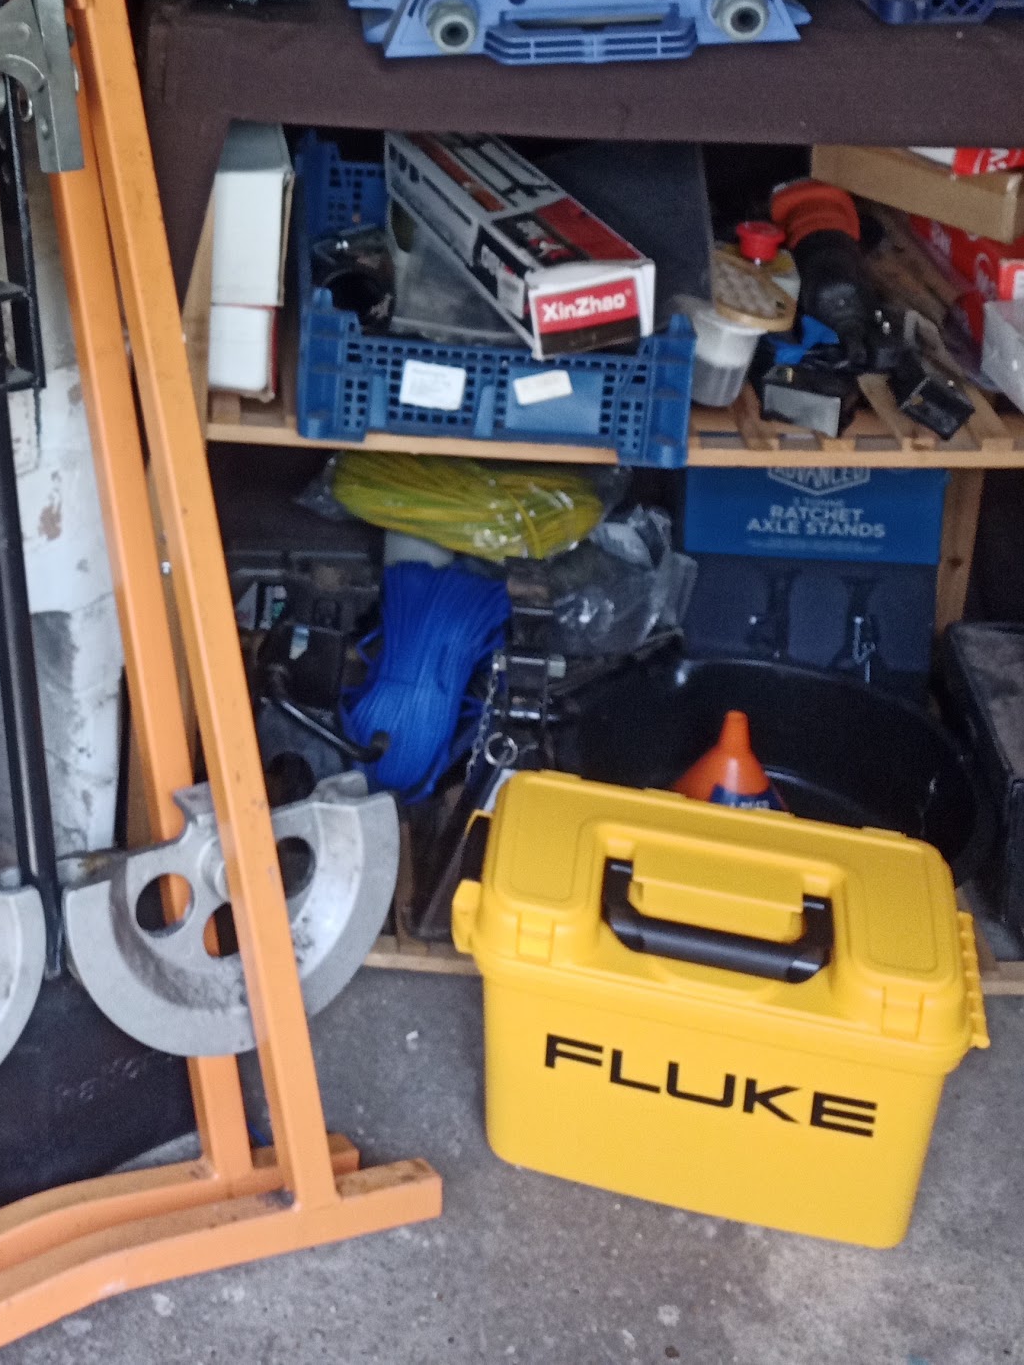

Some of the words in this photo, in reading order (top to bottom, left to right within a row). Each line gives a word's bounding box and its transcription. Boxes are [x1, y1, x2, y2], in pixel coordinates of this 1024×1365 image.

[542, 294, 627, 323] XinZhao
[770, 505, 864, 521] RATCHET
[747, 518, 800, 534] AXLE
[806, 522, 886, 538] STANDS
[544, 1032, 878, 1138] FLUKE
